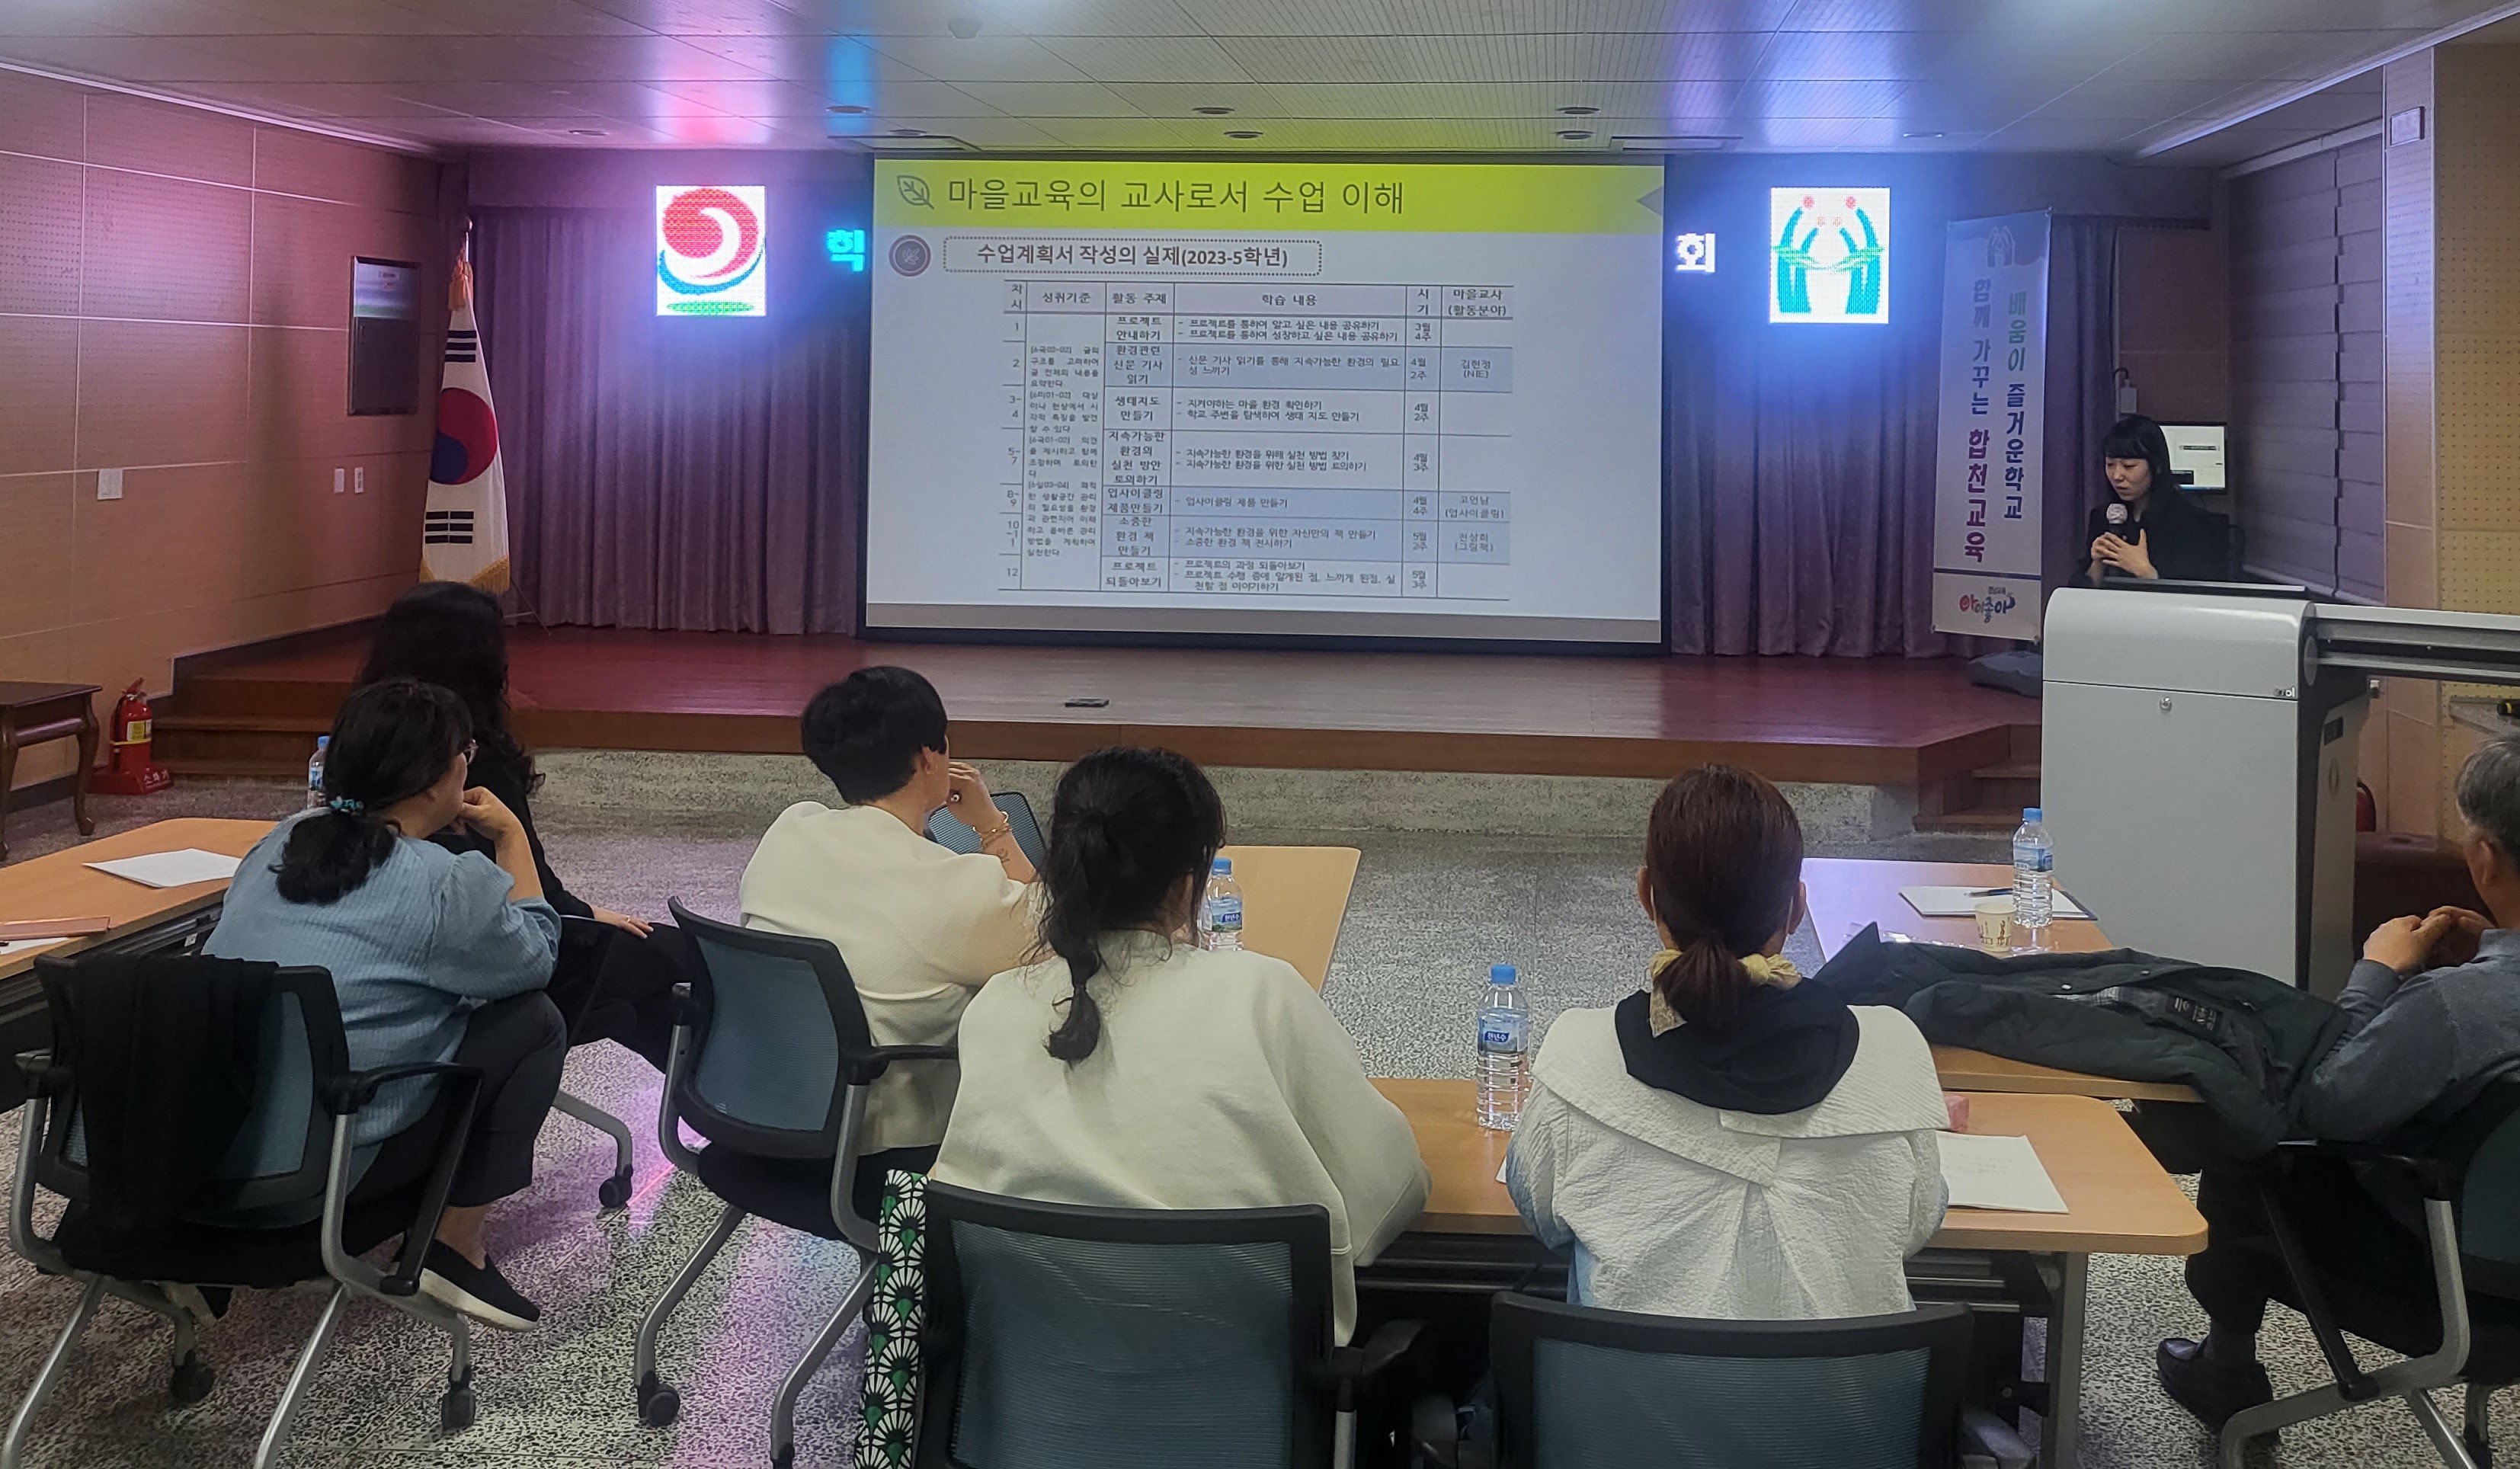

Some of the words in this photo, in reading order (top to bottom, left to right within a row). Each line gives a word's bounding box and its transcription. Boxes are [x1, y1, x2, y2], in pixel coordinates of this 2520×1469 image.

[949, 178, 1106, 211] 마을교육의
[1121, 181, 1247, 213] 교사로서
[1263, 181, 1324, 213] 수업
[1343, 181, 1403, 214] 이해
[978, 244, 1074, 265] 수업계획서
[1079, 245, 1136, 265] 작성의
[1143, 245, 1287, 267] 실제(2023-5학년)
[1676, 233, 1715, 273] 회
[1042, 292, 1091, 303] 성취기준
[1112, 293, 1137, 304] 활동
[1143, 293, 1166, 304] 주제
[1417, 289, 1429, 299] 시
[1453, 289, 1503, 300] 마을교사
[1262, 294, 1286, 306] 학습
[1294, 294, 1318, 306] 내용
[1973, 278, 1991, 328] 함께
[1417, 305, 1429, 315] 기
[1117, 316, 1162, 326] 프로젝트
[1190, 318, 1236, 328] 프로젝트를
[1240, 319, 1267, 329] 통하여
[1273, 321, 1292, 329] 알고
[1296, 321, 1315, 330] 싶은
[1320, 321, 1338, 330] 내용
[1342, 321, 1379, 331] 공유하기
[1415, 322, 1430, 332] 3월
[2008, 292, 2026, 371] 배움이
[1116, 330, 1161, 341] 안내하기
[1189, 330, 1236, 339] 프로젝트를
[1240, 330, 1267, 340] 통하여
[1272, 331, 1310, 341] 성장하고
[1314, 331, 1334, 341] 싶은
[1337, 331, 1357, 341] 내용
[1362, 331, 1398, 341] 공유하기
[1415, 332, 1431, 341] 4주
[1116, 345, 1161, 356] 환경관련
[1013, 359, 1020, 368] 2
[1114, 360, 1135, 371] 신문
[1142, 360, 1163, 371] 기사
[1189, 355, 1207, 365] 신문
[1212, 356, 1231, 365] 기사
[1237, 356, 1264, 366] 읽기를
[1271, 357, 1289, 366] 통해
[1295, 357, 1340, 367] 지속가능한
[1347, 357, 1374, 367] 환경의
[1381, 358, 1400, 367] 필요
[1410, 357, 1427, 366] 4월
[1202, 366, 1230, 376] 느끼기
[1410, 371, 1427, 380] 2주
[1464, 370, 1488, 379] (NIE)
[1971, 338, 1991, 415] 가꾸는
[1126, 374, 1148, 385] 읽기
[1116, 396, 1161, 406] 생태지도
[1238, 400, 1258, 409] 마을
[1262, 400, 1280, 409] 환경
[1286, 400, 1322, 411] 확인하기
[1414, 403, 1429, 412] 4월
[1120, 411, 1154, 421] 만들기
[1187, 409, 1207, 419] 학교
[1210, 410, 1238, 420] 주변을
[1286, 411, 1303, 421] 생태
[1308, 411, 1327, 421] 지도
[1332, 411, 1359, 421] 만들기
[1414, 413, 1429, 422] 2주
[1109, 431, 1166, 442] 지속가능한
[1119, 446, 1152, 456] 환경의
[1235, 450, 1261, 459] 환경을
[1266, 450, 1283, 459] 위해
[1287, 450, 1305, 459] 실천
[1309, 451, 1327, 460] 방법
[1332, 451, 1349, 460] 찾기
[1011, 456, 1017, 465] 7
[1112, 459, 1132, 471] 실천
[1140, 460, 1161, 471] 방안
[1235, 460, 1261, 470] 환경을
[1266, 460, 1283, 470] 위한
[1287, 461, 1305, 470] 실천
[1309, 461, 1327, 471] 방법
[1331, 461, 1366, 471] 토의하기
[1414, 463, 1429, 472] 3주
[1115, 475, 1158, 485] 토의하기
[1108, 488, 1164, 499] 업사이클링
[1964, 429, 1990, 563] 합천교육
[1108, 503, 1163, 514] 제품만들기
[1237, 498, 1257, 507] 제품
[1260, 498, 1288, 508] 만들기
[1119, 517, 1152, 526] 소중한
[1116, 531, 1137, 541] 환경
[1144, 532, 1154, 542] 책
[1237, 528, 1263, 537] 환경을
[1270, 528, 1288, 538] 위한
[1348, 530, 1375, 540] 만들기
[1185, 537, 1213, 547] 소중한
[1218, 538, 1236, 547] 환경
[1118, 546, 1151, 556] 만들기
[1112, 562, 1157, 571] 프로젝트
[1236, 560, 1254, 570] 과정
[1259, 561, 1305, 571] 되돌아보기
[1106, 577, 1161, 587] 되돌아보기
